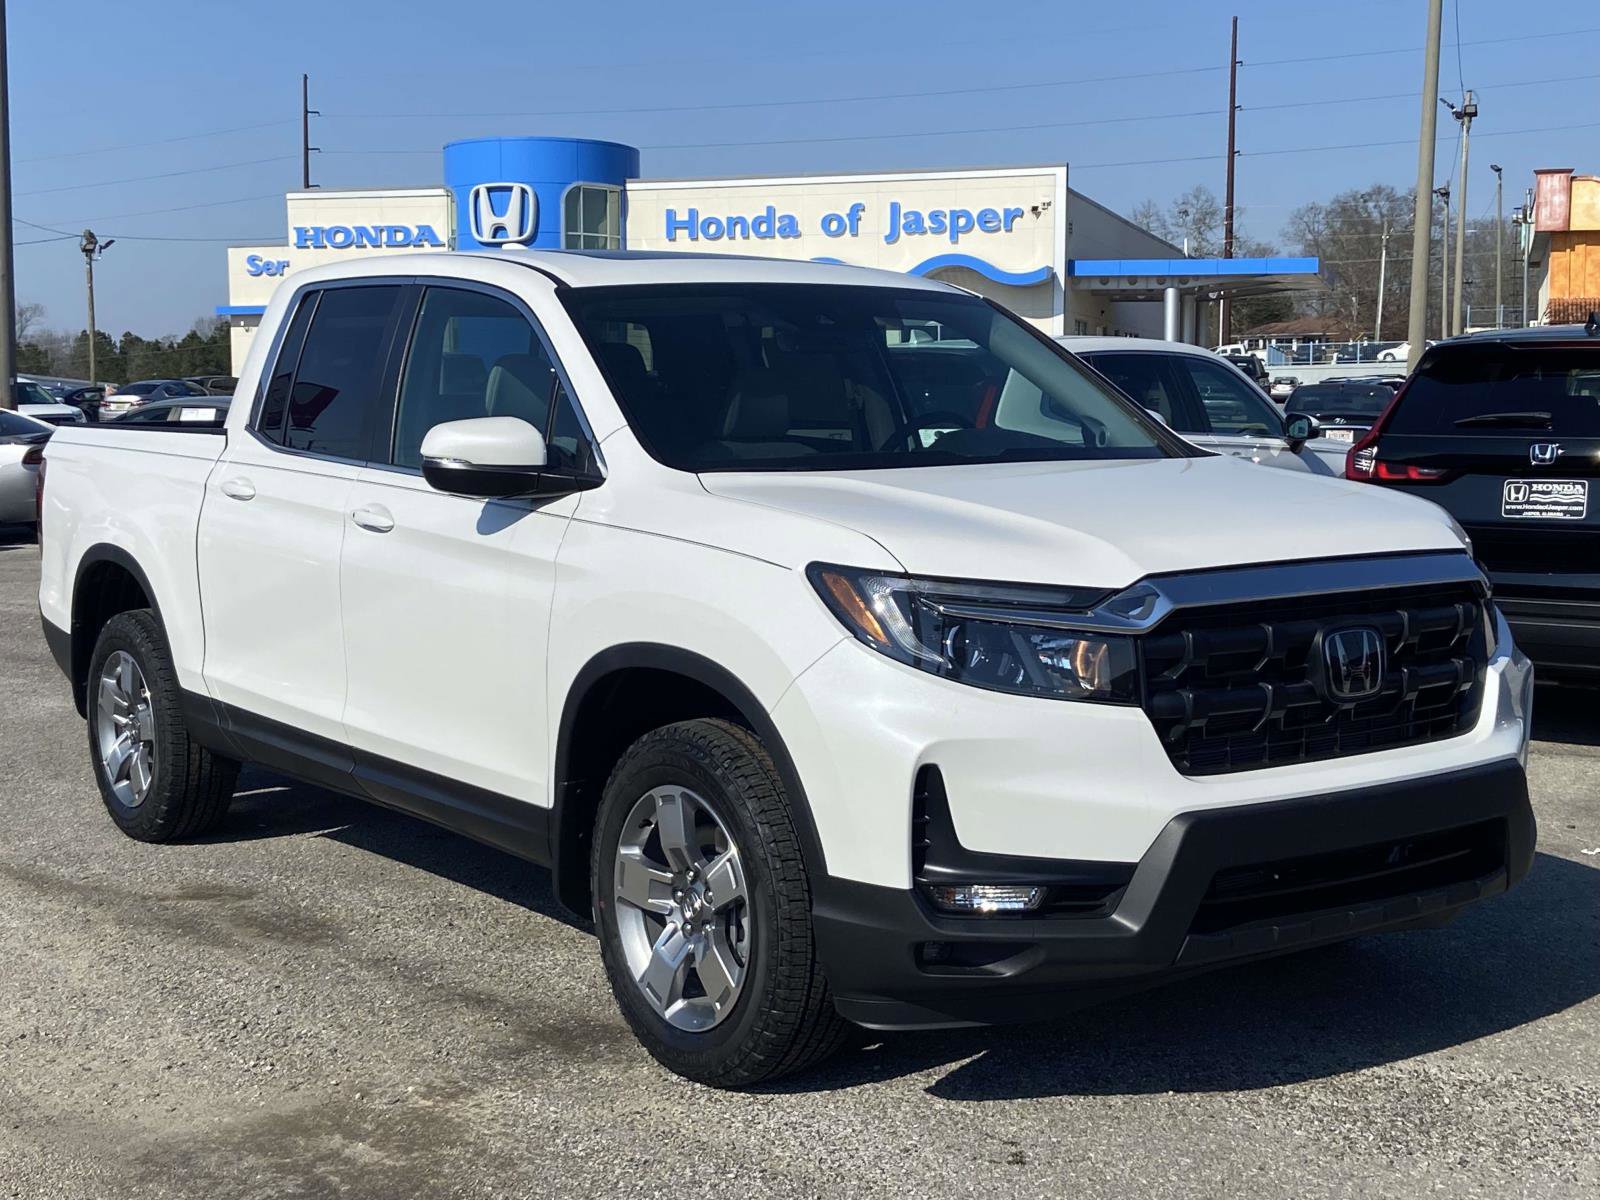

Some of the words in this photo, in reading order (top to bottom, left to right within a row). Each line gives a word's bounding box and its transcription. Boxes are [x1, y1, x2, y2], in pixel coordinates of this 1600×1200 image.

[665, 205, 801, 241] Honda
[820, 202, 866, 238] of
[884, 201, 1025, 245] Jasper
[293, 224, 446, 249] HONDA
[1531, 483, 1584, 492] HONDA
